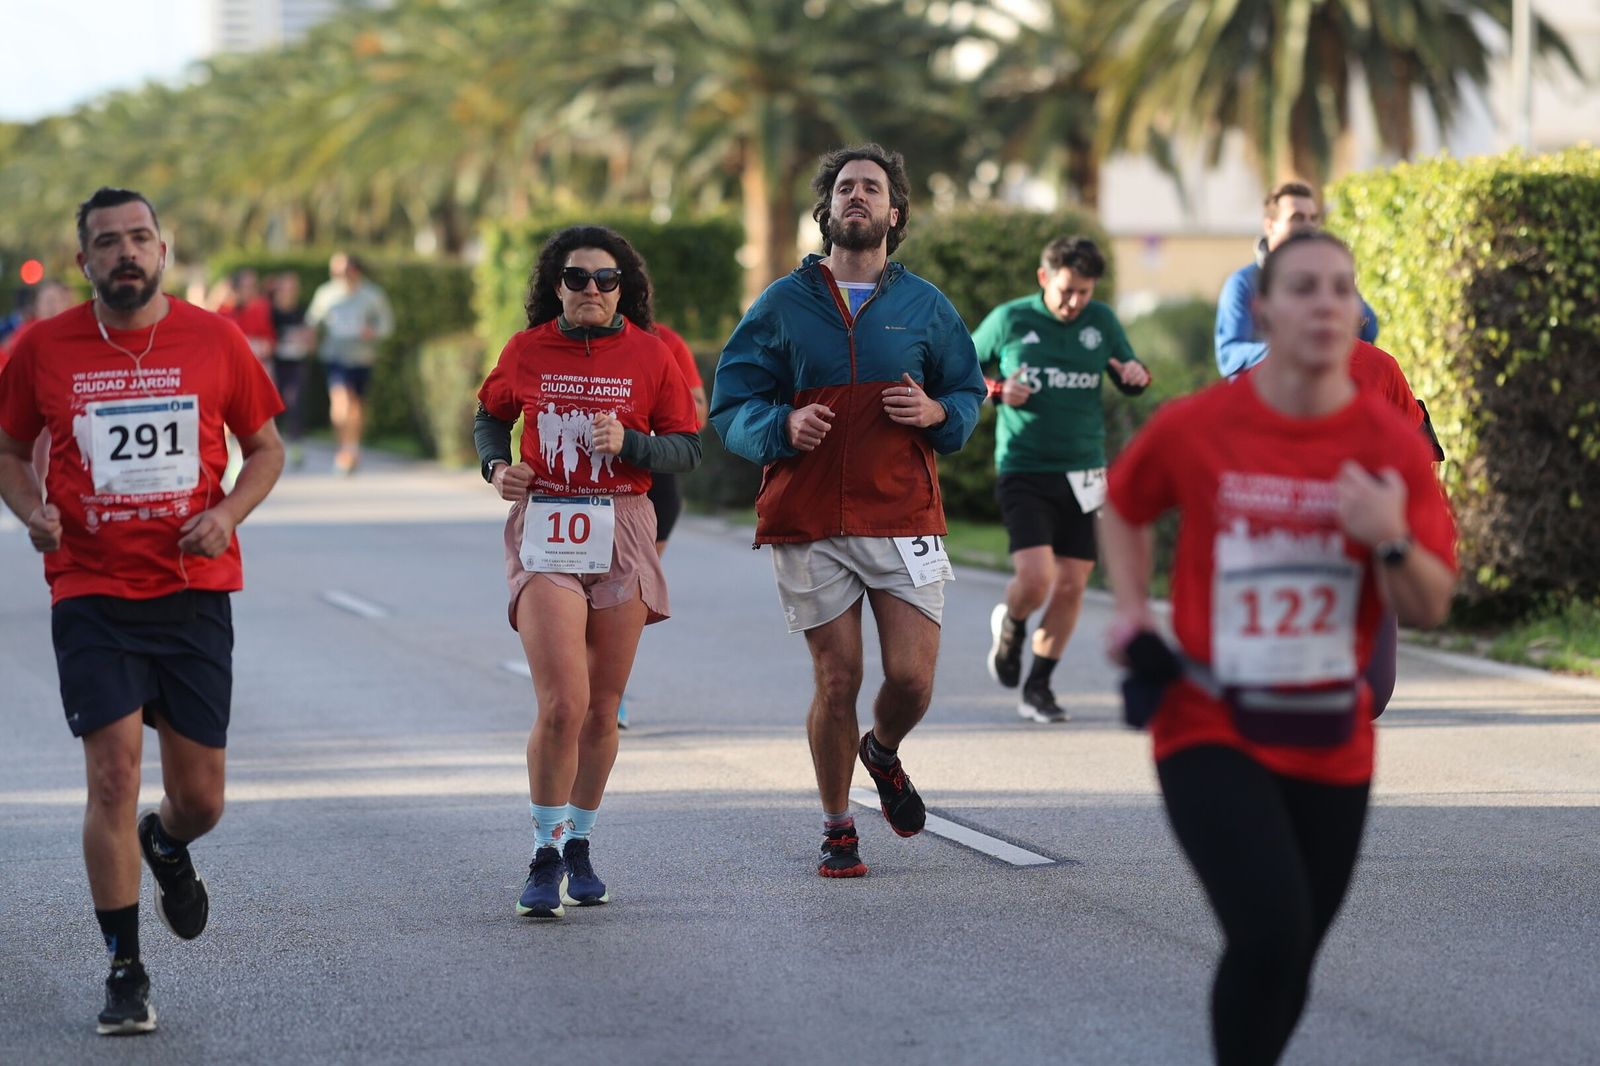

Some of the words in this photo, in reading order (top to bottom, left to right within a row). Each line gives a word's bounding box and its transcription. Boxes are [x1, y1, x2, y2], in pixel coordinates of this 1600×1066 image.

[87, 370, 129, 380] CARRERA
[168, 367, 181, 376] DE
[552, 374, 589, 383] CARRERA
[590, 376, 621, 385] URBANA
[622, 378, 633, 386] DE
[1043, 367, 1100, 389] Tezos
[73, 379, 126, 394] CIUDAD
[129, 376, 181, 390] JARDÍN
[540, 382, 584, 394] CIUDAD
[587, 385, 631, 397] JARDÍN
[108, 421, 184, 461] 291
[535, 478, 564, 492] Domingo
[565, 485, 570, 493] 8
[578, 486, 608, 494] febrero
[615, 483, 632, 493] 2026
[547, 511, 591, 545] 10
[1239, 584, 1339, 639] 122
